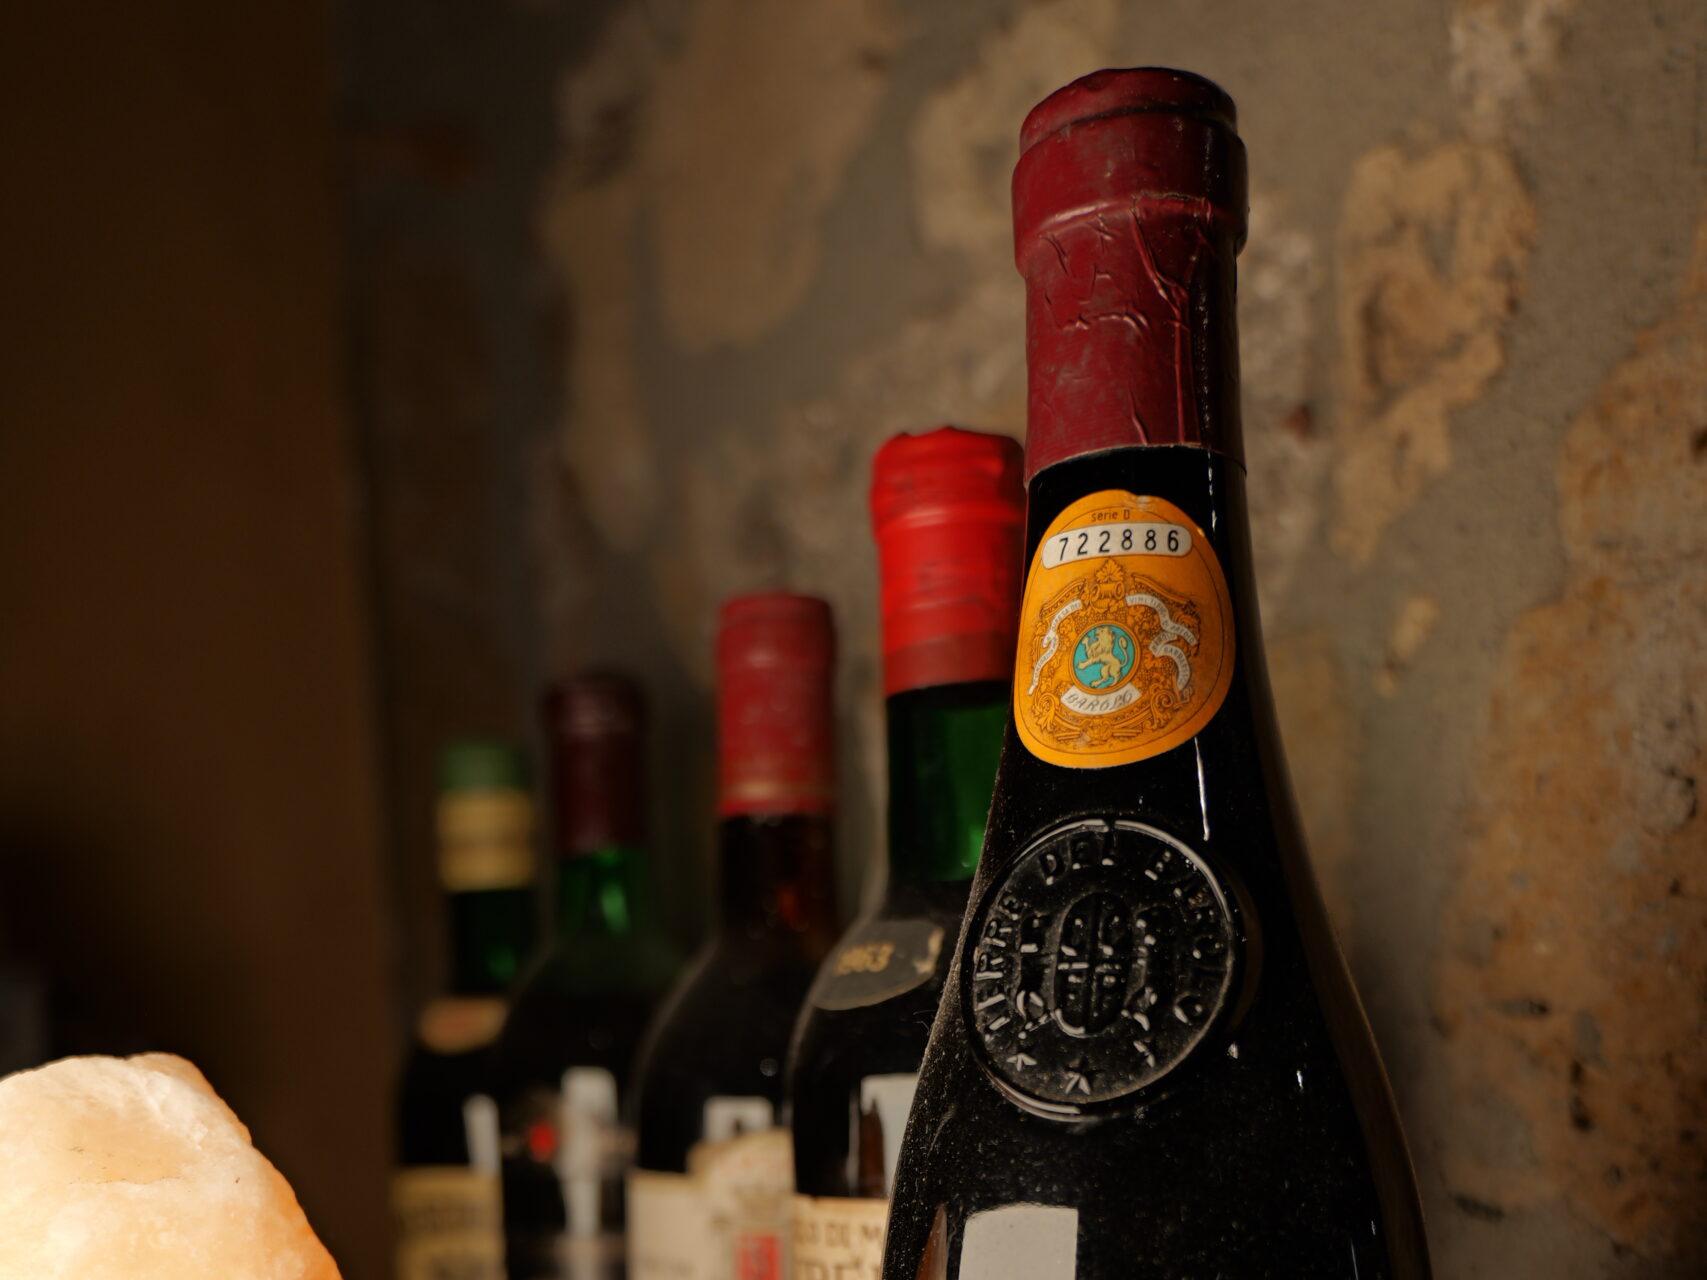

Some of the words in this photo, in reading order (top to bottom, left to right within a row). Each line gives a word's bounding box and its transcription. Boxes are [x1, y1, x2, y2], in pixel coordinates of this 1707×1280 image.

[1091, 511, 1119, 523] serie
[1123, 509, 1131, 520] D
[1058, 528, 1179, 561] 722886
[1065, 689, 1133, 712] BAROLO
